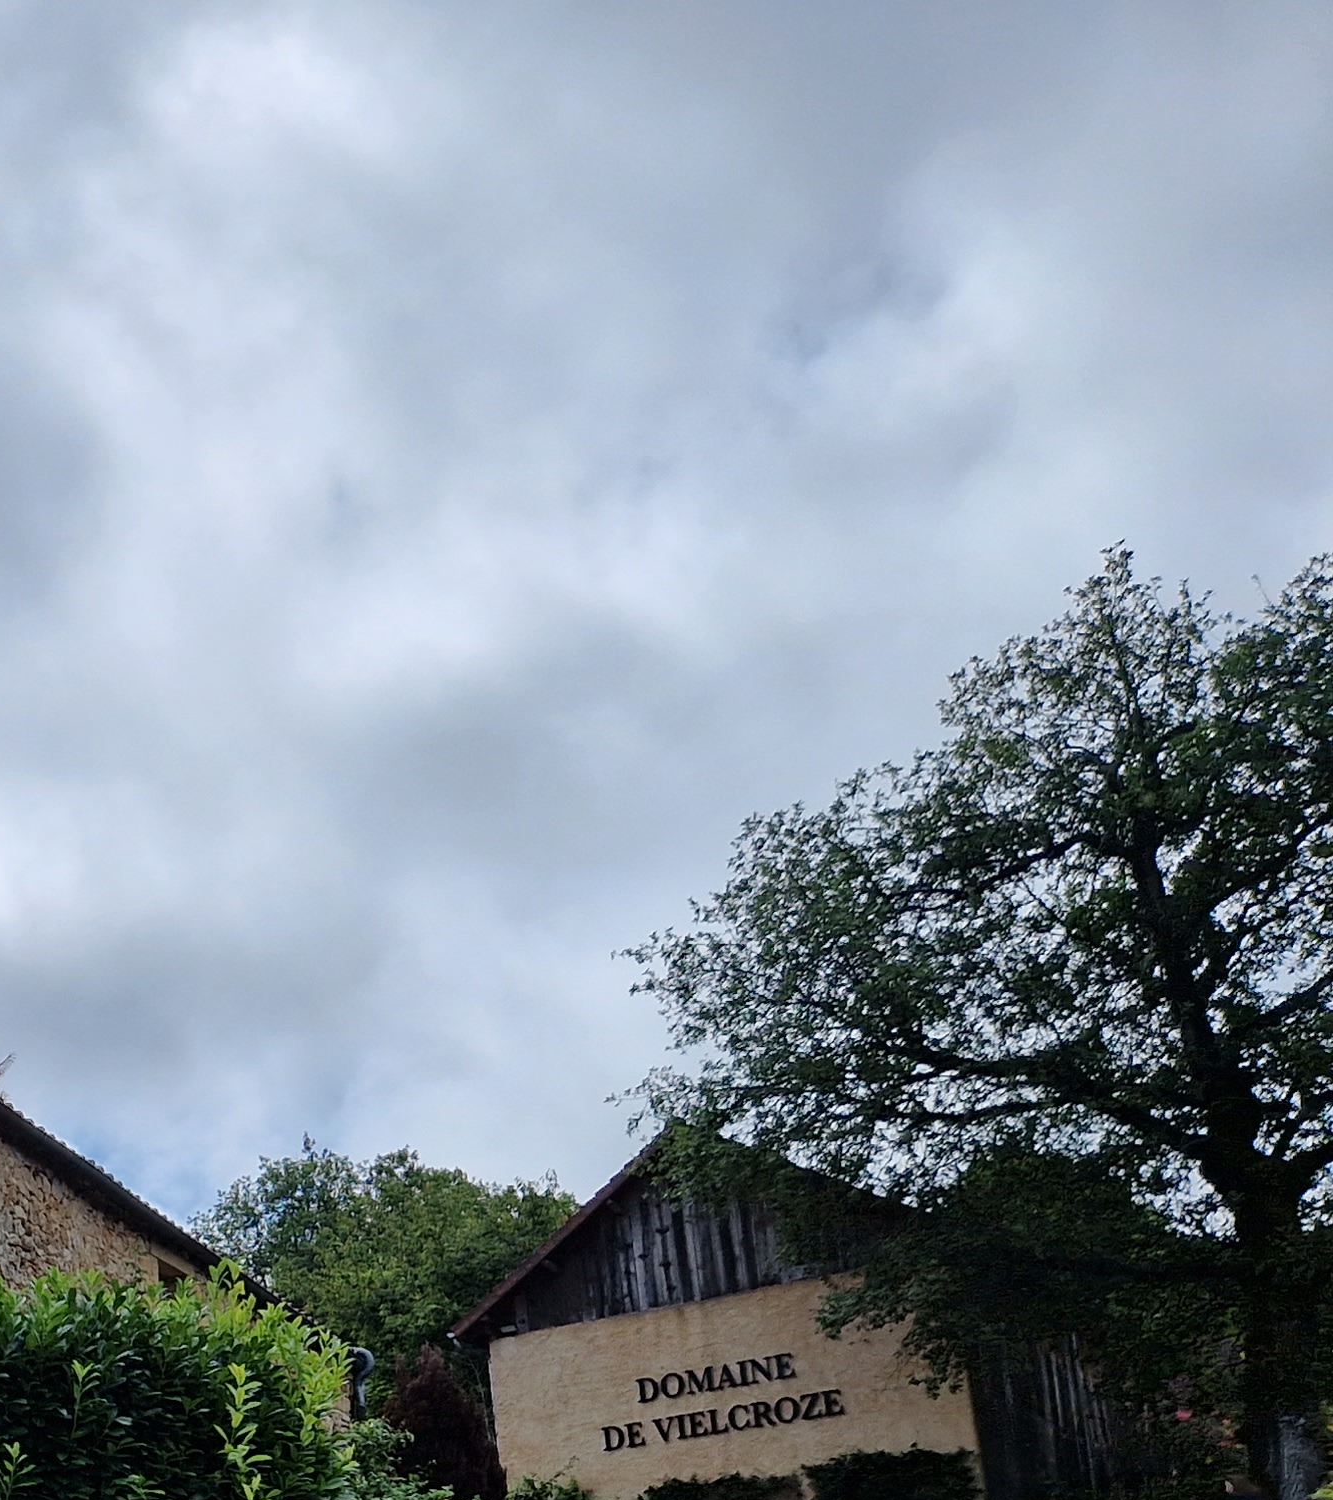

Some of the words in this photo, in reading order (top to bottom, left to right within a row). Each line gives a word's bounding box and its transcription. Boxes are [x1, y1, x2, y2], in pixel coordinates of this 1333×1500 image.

[635, 1352, 797, 1403] DOMAINE
[601, 1421, 646, 1452] DE
[652, 1389, 845, 1443] VIELCROZE
